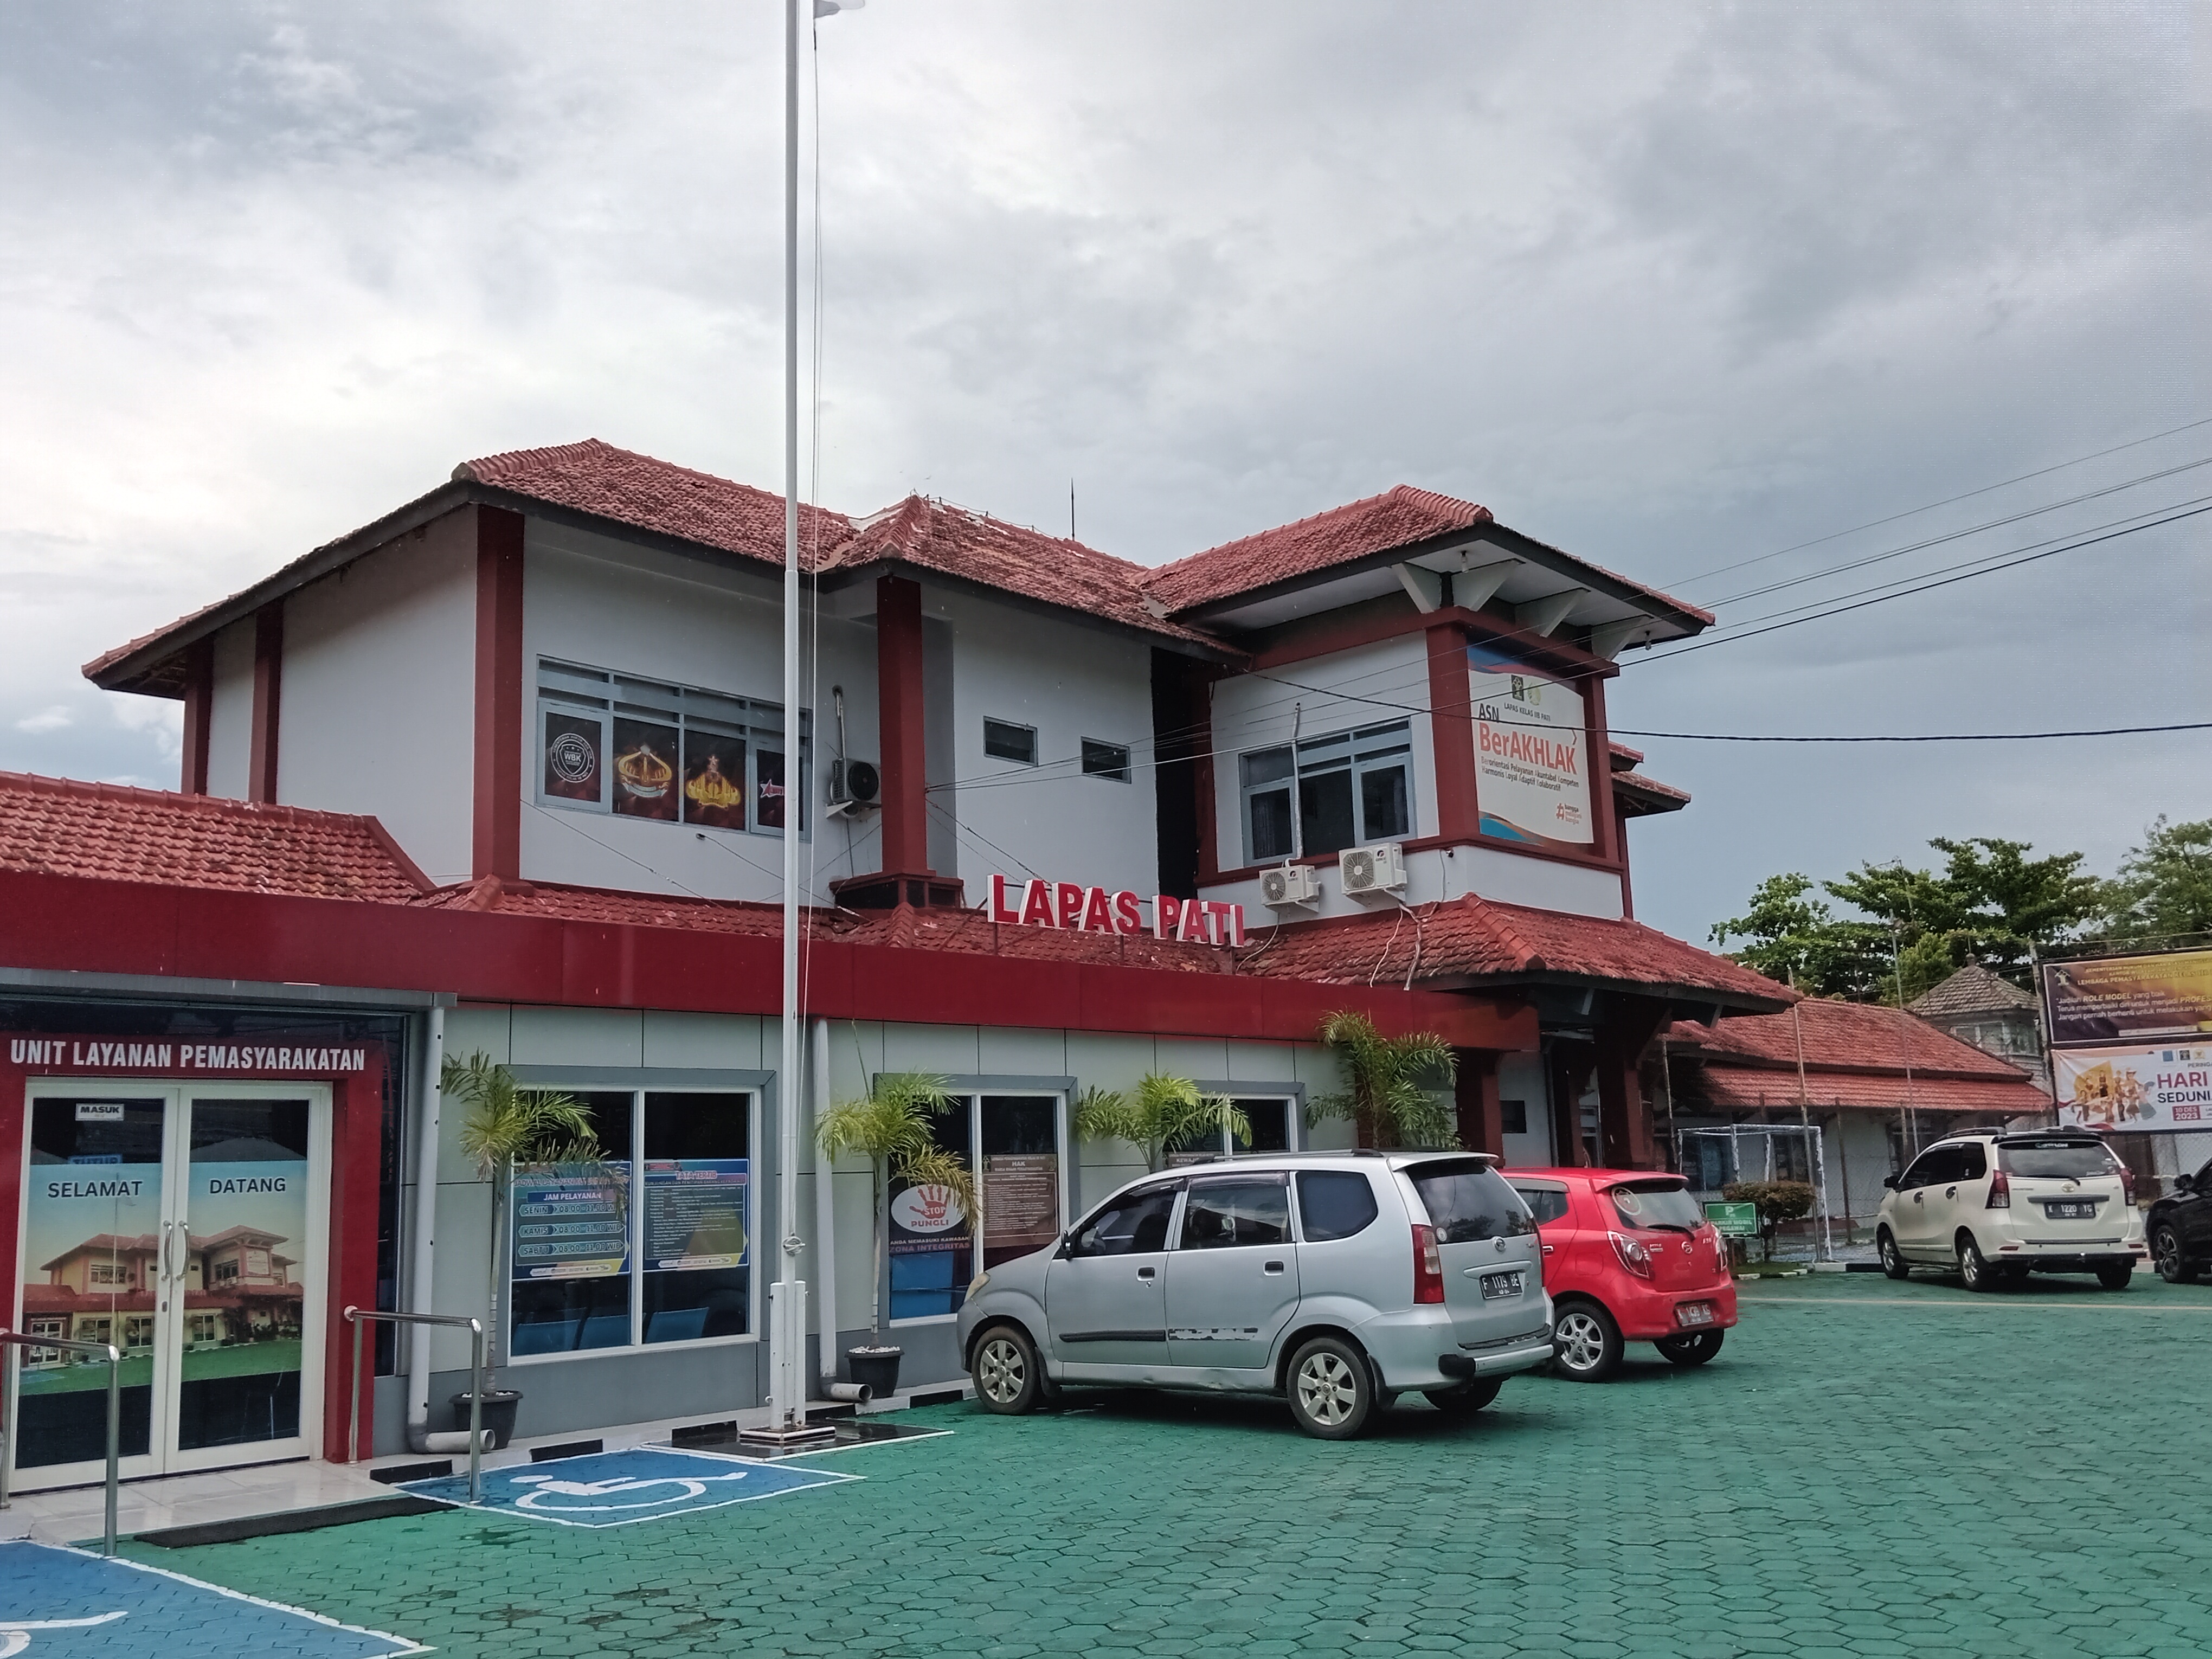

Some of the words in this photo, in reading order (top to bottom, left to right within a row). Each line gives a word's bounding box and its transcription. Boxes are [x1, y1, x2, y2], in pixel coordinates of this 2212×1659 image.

[1478, 703, 1500, 721] ASN
[1504, 702, 1519, 712] LAPAS
[1519, 707, 1534, 717] KELAS
[1541, 713, 1551, 722] PATI
[1479, 722, 1577, 775] BerAKHLAK
[564, 753, 582, 762] WBK
[1481, 756, 1510, 770] Berorientasi
[1510, 763, 1534, 776] Pelayanan
[1481, 766, 1504, 778] Harmonis
[1505, 771, 1517, 782] Loyal
[987, 874, 1141, 935] LAPAS
[1152, 895, 1245, 947] PATI
[2077, 978, 2108, 986] LEMBAGA
[2082, 994, 2104, 1002] ROLE
[2105, 993, 2132, 1001] MODEL
[2057, 1013, 2082, 1021] Jangan
[10, 1039, 66, 1065] UNIT
[73, 1041, 172, 1067] LAYANAN
[180, 1045, 365, 1071] PEMASYARAKATAN
[2157, 1071, 2208, 1089] HARI
[2158, 1090, 2212, 1103] SEDUNI
[47, 1181, 143, 1198] SELAMAT
[210, 1178, 286, 1194] DATANG
[560, 1192, 602, 1201] PELAYANAN
[524, 1206, 548, 1214] SENIN
[586, 1204, 605, 1212] 11.00
[924, 1206, 946, 1216] STOP
[1725, 1205, 1734, 1216] P
[2061, 1204, 2077, 1212] 1220
[523, 1226, 548, 1234] KAMIS
[586, 1224, 606, 1232] 11.00
[607, 1223, 620, 1231] WIB
[524, 1246, 549, 1255] SABTU
[586, 1243, 606, 1252] 11.00
[607, 1242, 620, 1251] WIB
[916, 1242, 970, 1252] INTEGRITAS
[1482, 1277, 1488, 1290] F
[1491, 1275, 1508, 1289] 1179
